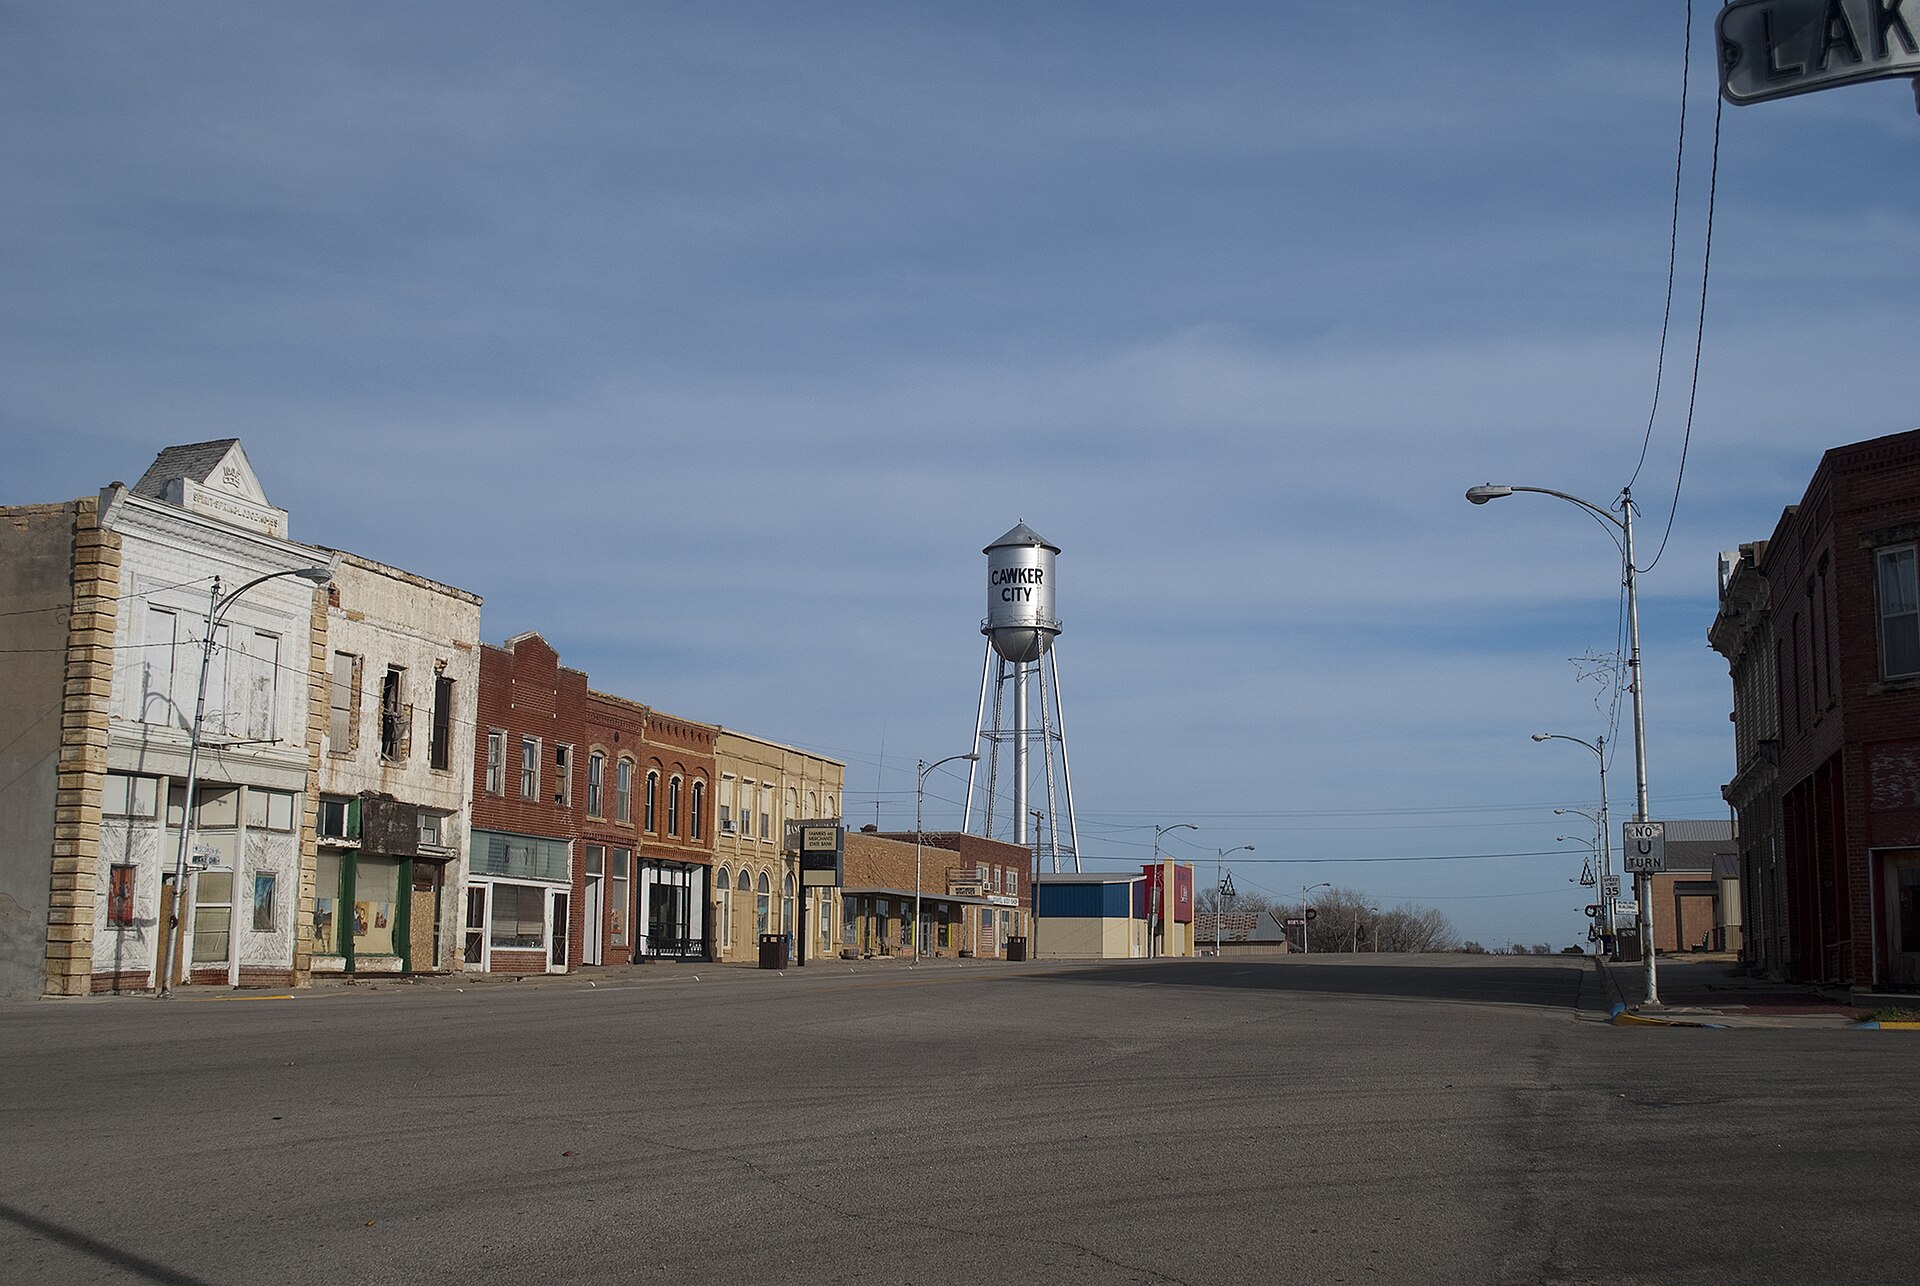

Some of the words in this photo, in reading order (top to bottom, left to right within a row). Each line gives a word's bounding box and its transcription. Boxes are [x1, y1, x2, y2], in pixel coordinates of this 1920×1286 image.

[991, 567, 1044, 585] CAWKER
[1001, 587, 1032, 602] CITY
[1635, 827, 1652, 837] NO
[1637, 840, 1652, 855] U
[1629, 857, 1660, 868] TURN
[1605, 887, 1619, 896] 35
